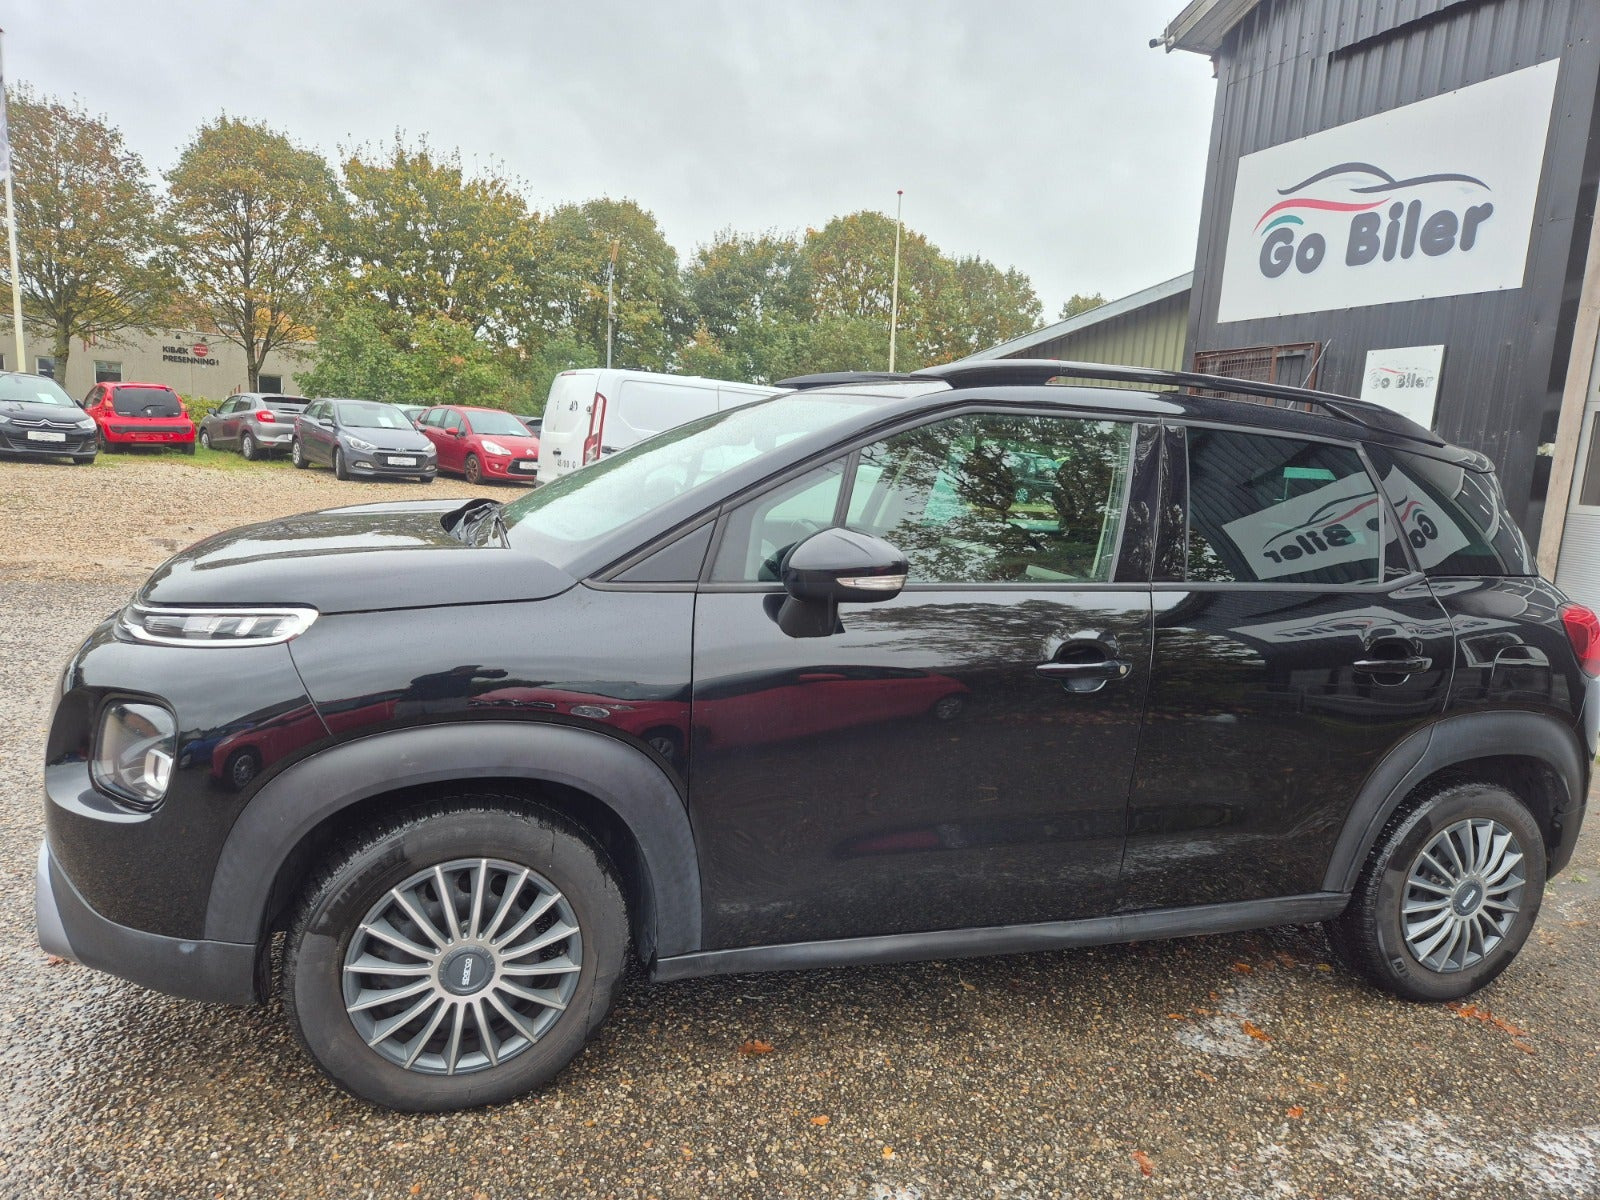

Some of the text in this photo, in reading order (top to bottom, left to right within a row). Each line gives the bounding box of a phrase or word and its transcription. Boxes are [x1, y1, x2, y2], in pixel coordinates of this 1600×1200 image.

[1259, 199, 1494, 279] Go Biler
[1395, 372, 1434, 389] Biler
